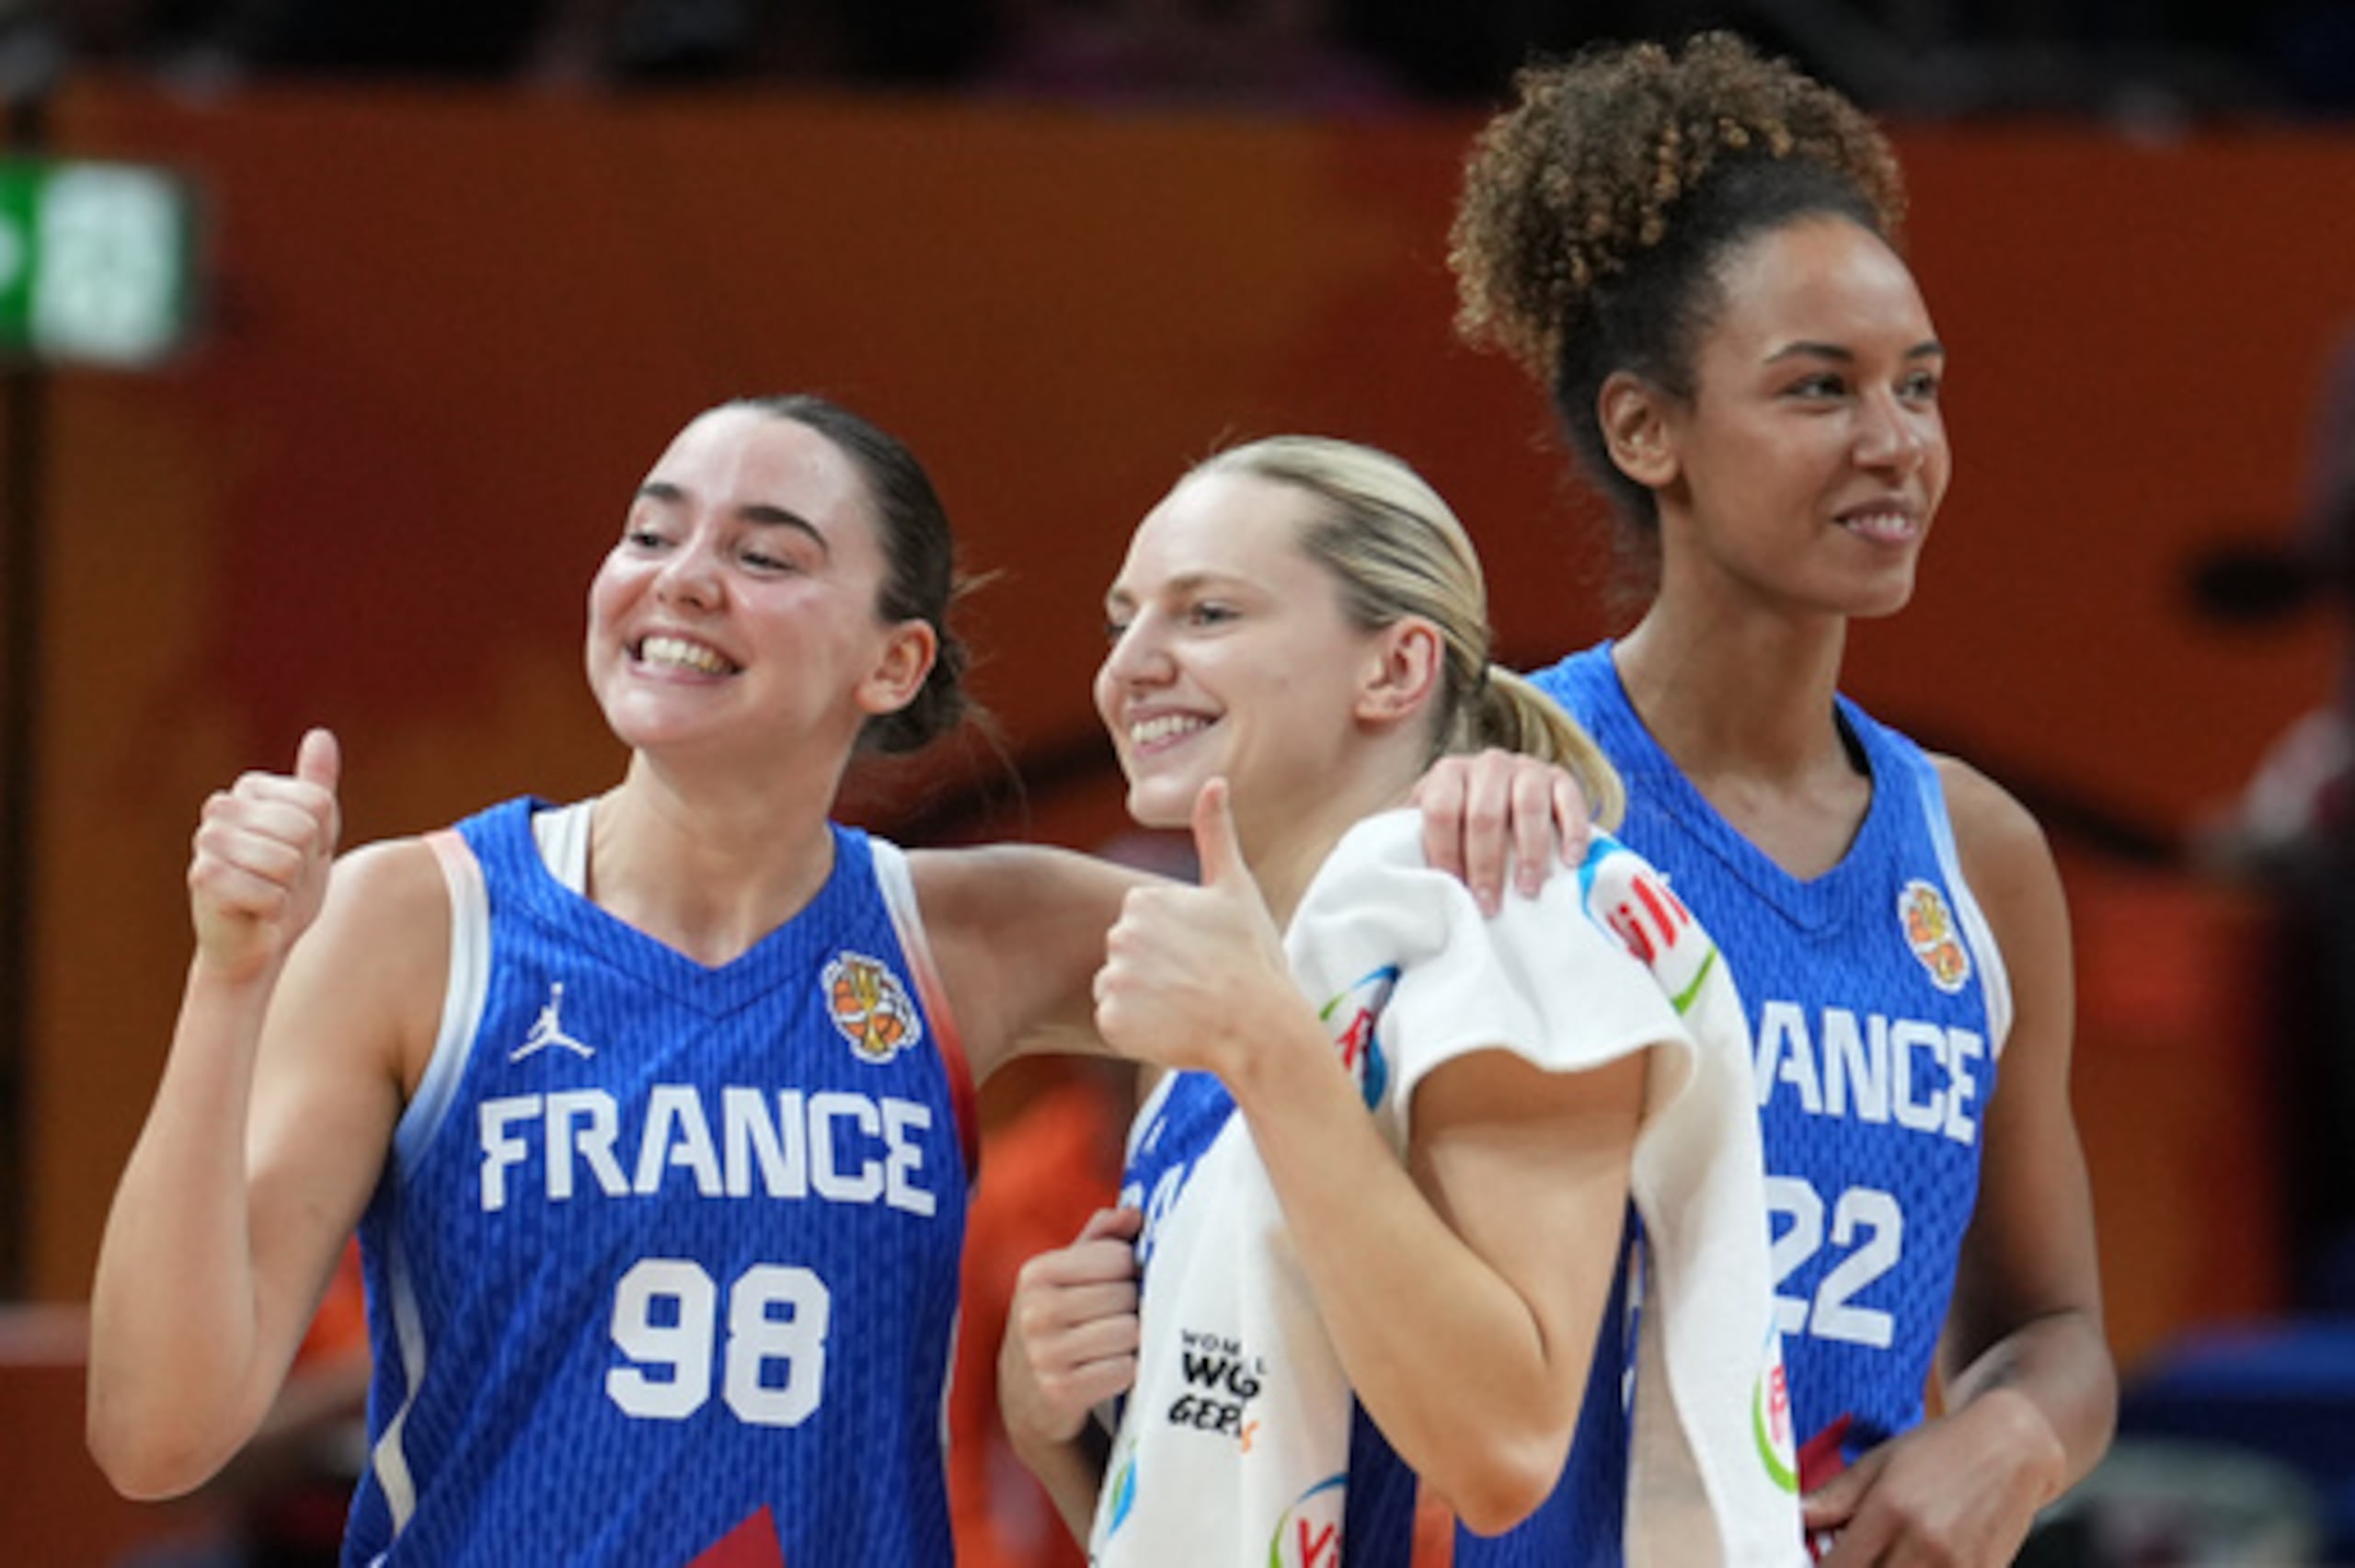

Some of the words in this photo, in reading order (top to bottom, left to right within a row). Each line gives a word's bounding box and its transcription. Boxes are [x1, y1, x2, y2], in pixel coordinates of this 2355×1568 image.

[478, 1083, 936, 1217] FRANCE
[1752, 1000, 1984, 1146] ANCE
[1763, 1174, 1904, 1349] 22
[604, 1257, 830, 1427] 98
